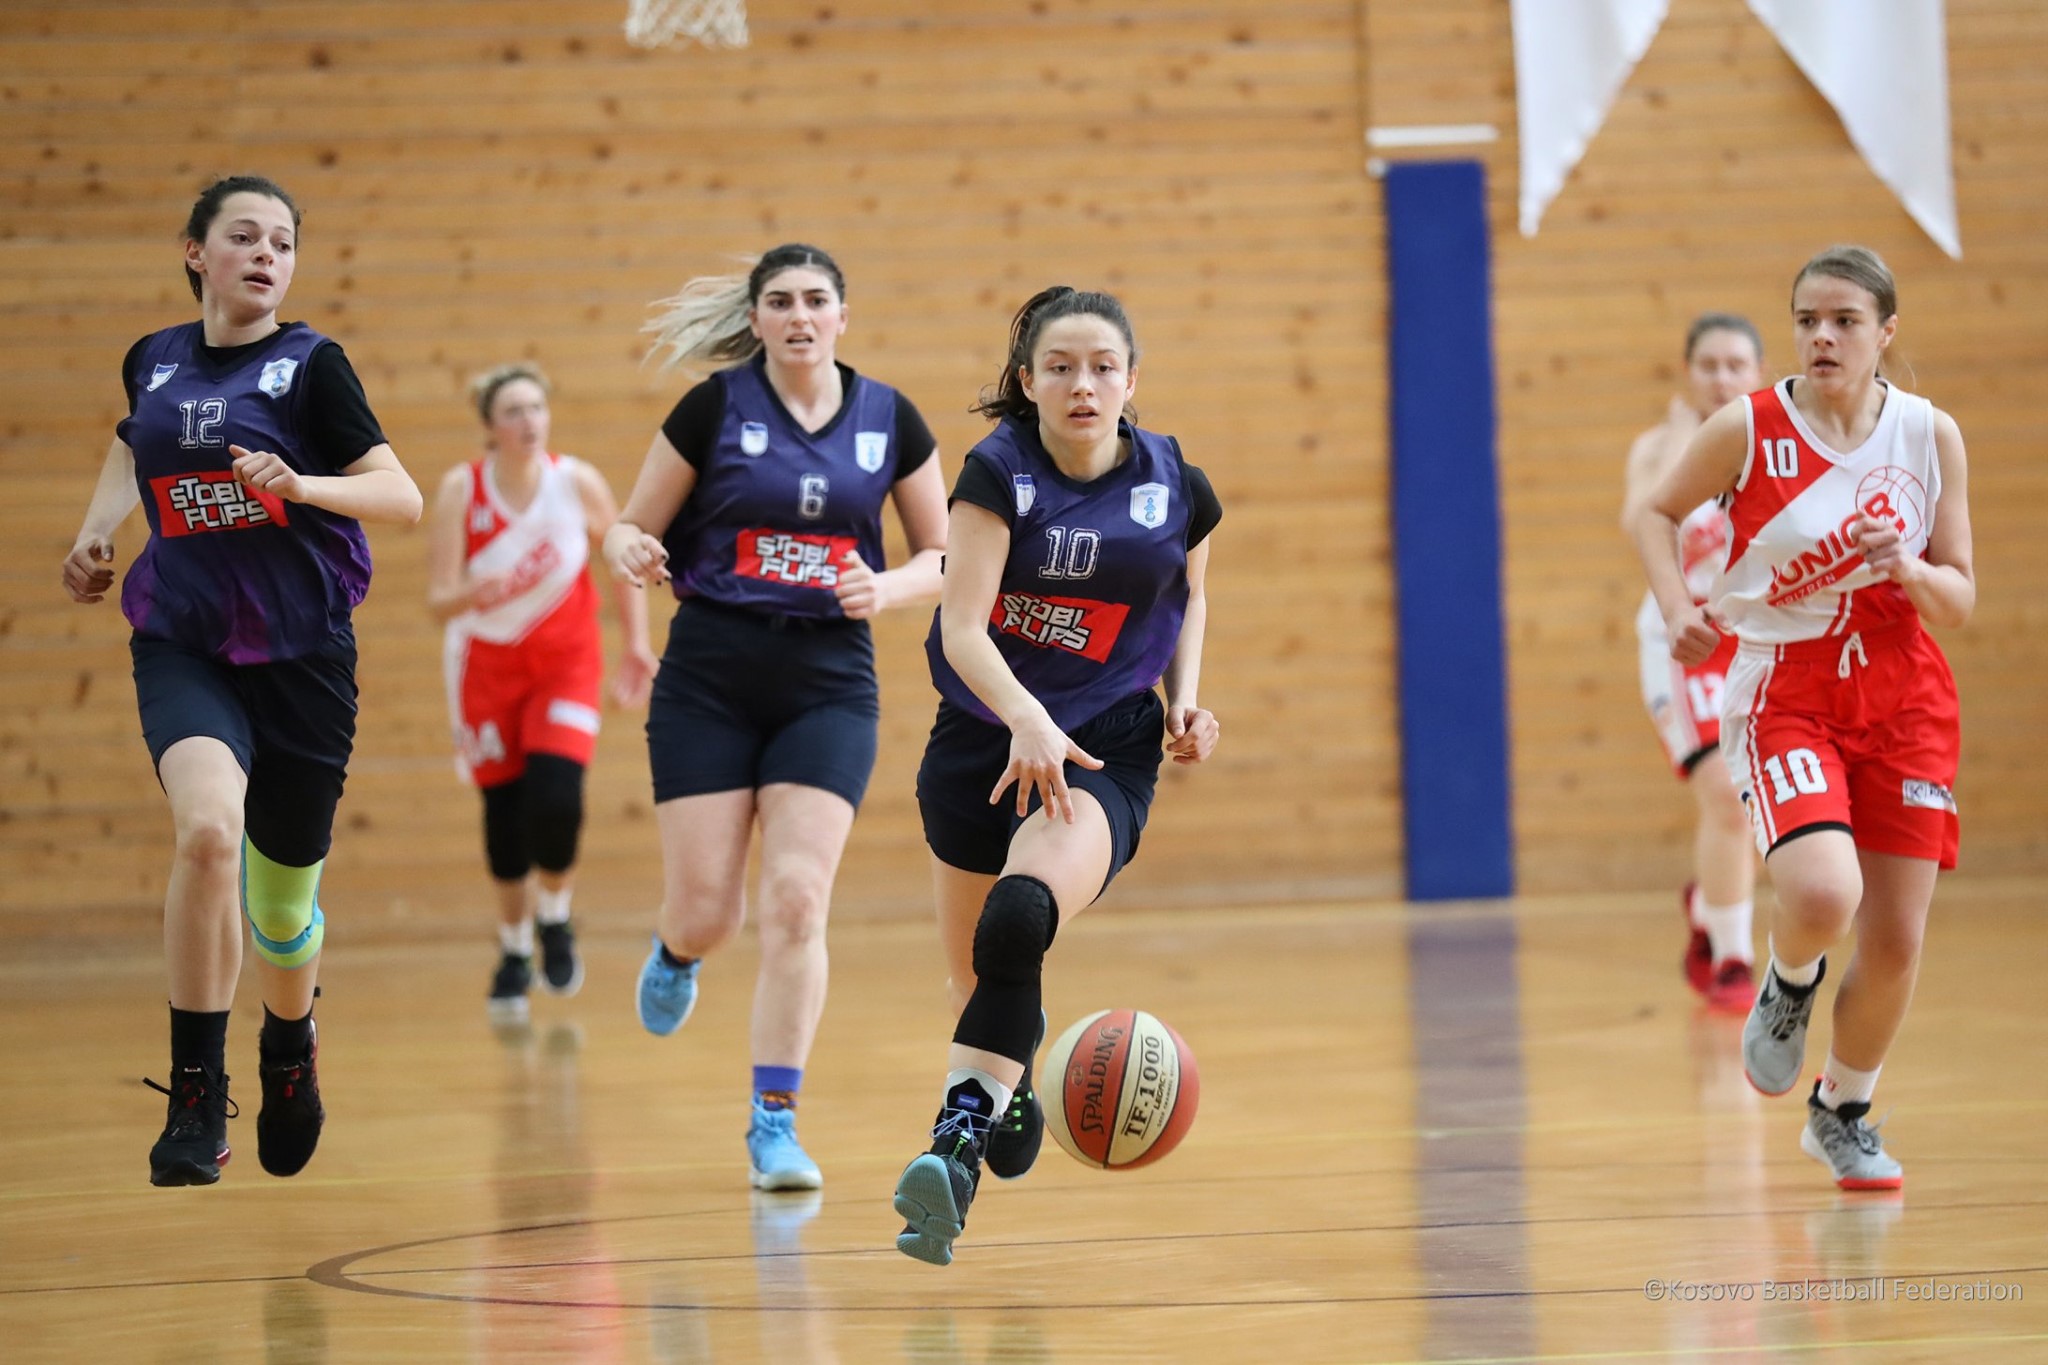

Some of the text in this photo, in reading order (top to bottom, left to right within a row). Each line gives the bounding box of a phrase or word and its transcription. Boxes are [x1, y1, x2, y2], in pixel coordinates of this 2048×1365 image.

[179, 398, 227, 448] 12
[1762, 438, 1798, 478] 10
[169, 477, 245, 510] STOBI
[799, 473, 829, 520] 6
[184, 500, 270, 530] FLIPS
[756, 534, 830, 563] STOBI
[1038, 526, 1101, 579] 10
[759, 557, 838, 586] FLIPS
[1002, 594, 1085, 628] STOBI
[1764, 747, 1828, 805] 10
[1081, 1026, 1122, 1134] SPALDING
